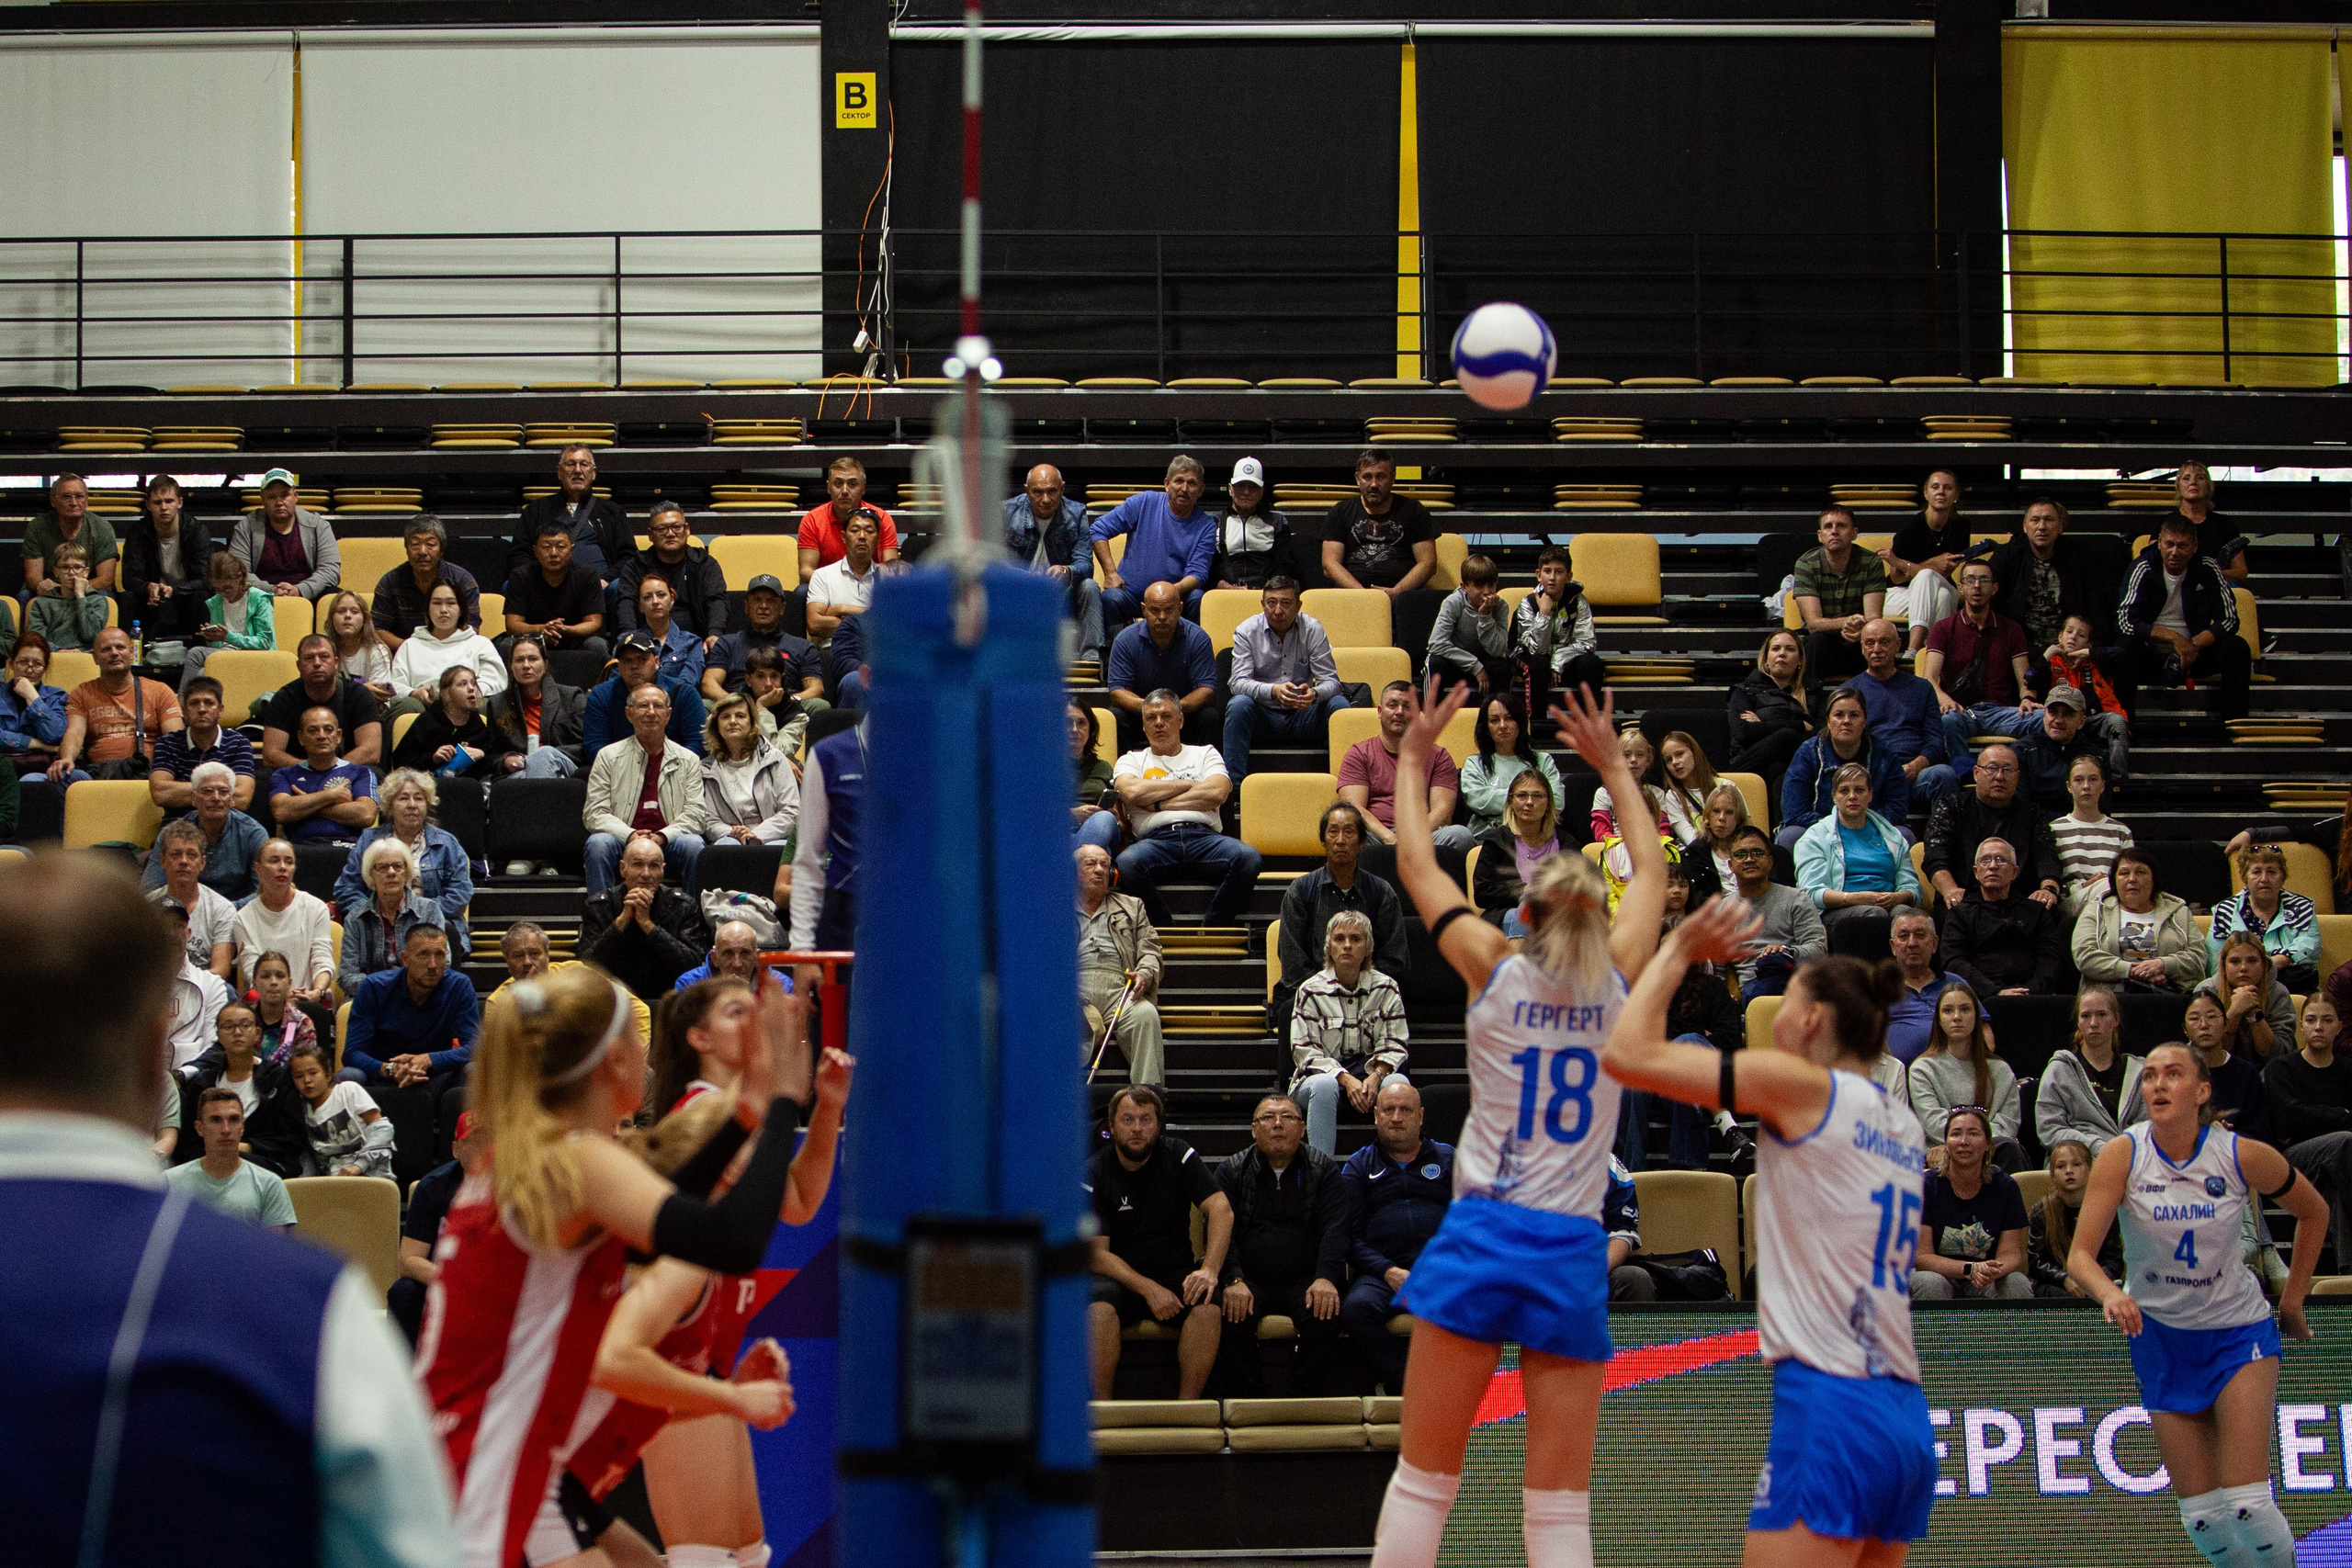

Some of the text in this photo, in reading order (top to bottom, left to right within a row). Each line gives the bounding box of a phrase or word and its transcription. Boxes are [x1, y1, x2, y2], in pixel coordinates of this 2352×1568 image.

[844, 82, 867, 109] В
[1513, 1000, 1604, 1032] ГЕРГЕРТ
[1512, 1045, 1597, 1145] 18
[2154, 1202, 2216, 1222] САХАЛИН
[1871, 1181, 1921, 1296] 15
[2174, 1229, 2198, 1269] 4
[2165, 1269, 2222, 1288] ГАЗПРОМБК
